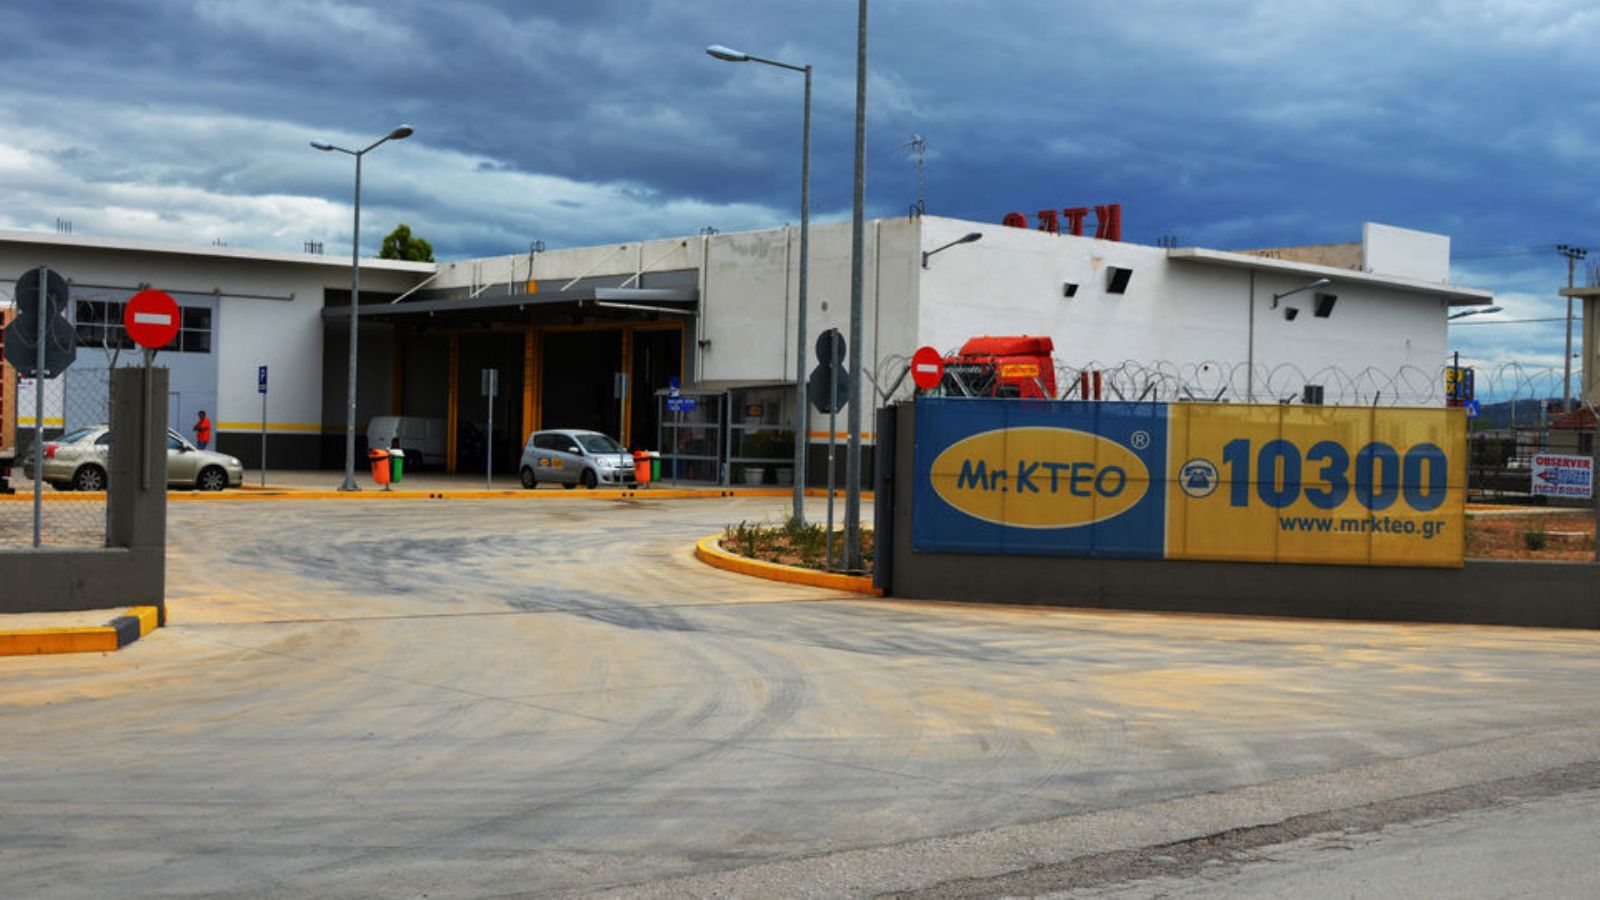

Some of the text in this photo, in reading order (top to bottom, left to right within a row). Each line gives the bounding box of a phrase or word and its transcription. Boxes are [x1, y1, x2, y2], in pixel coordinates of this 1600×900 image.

[1536, 456, 1591, 469] OBSERVER
[1222, 438, 1448, 512] 10300
[1280, 516, 1445, 539] www.mrkteo.gr
